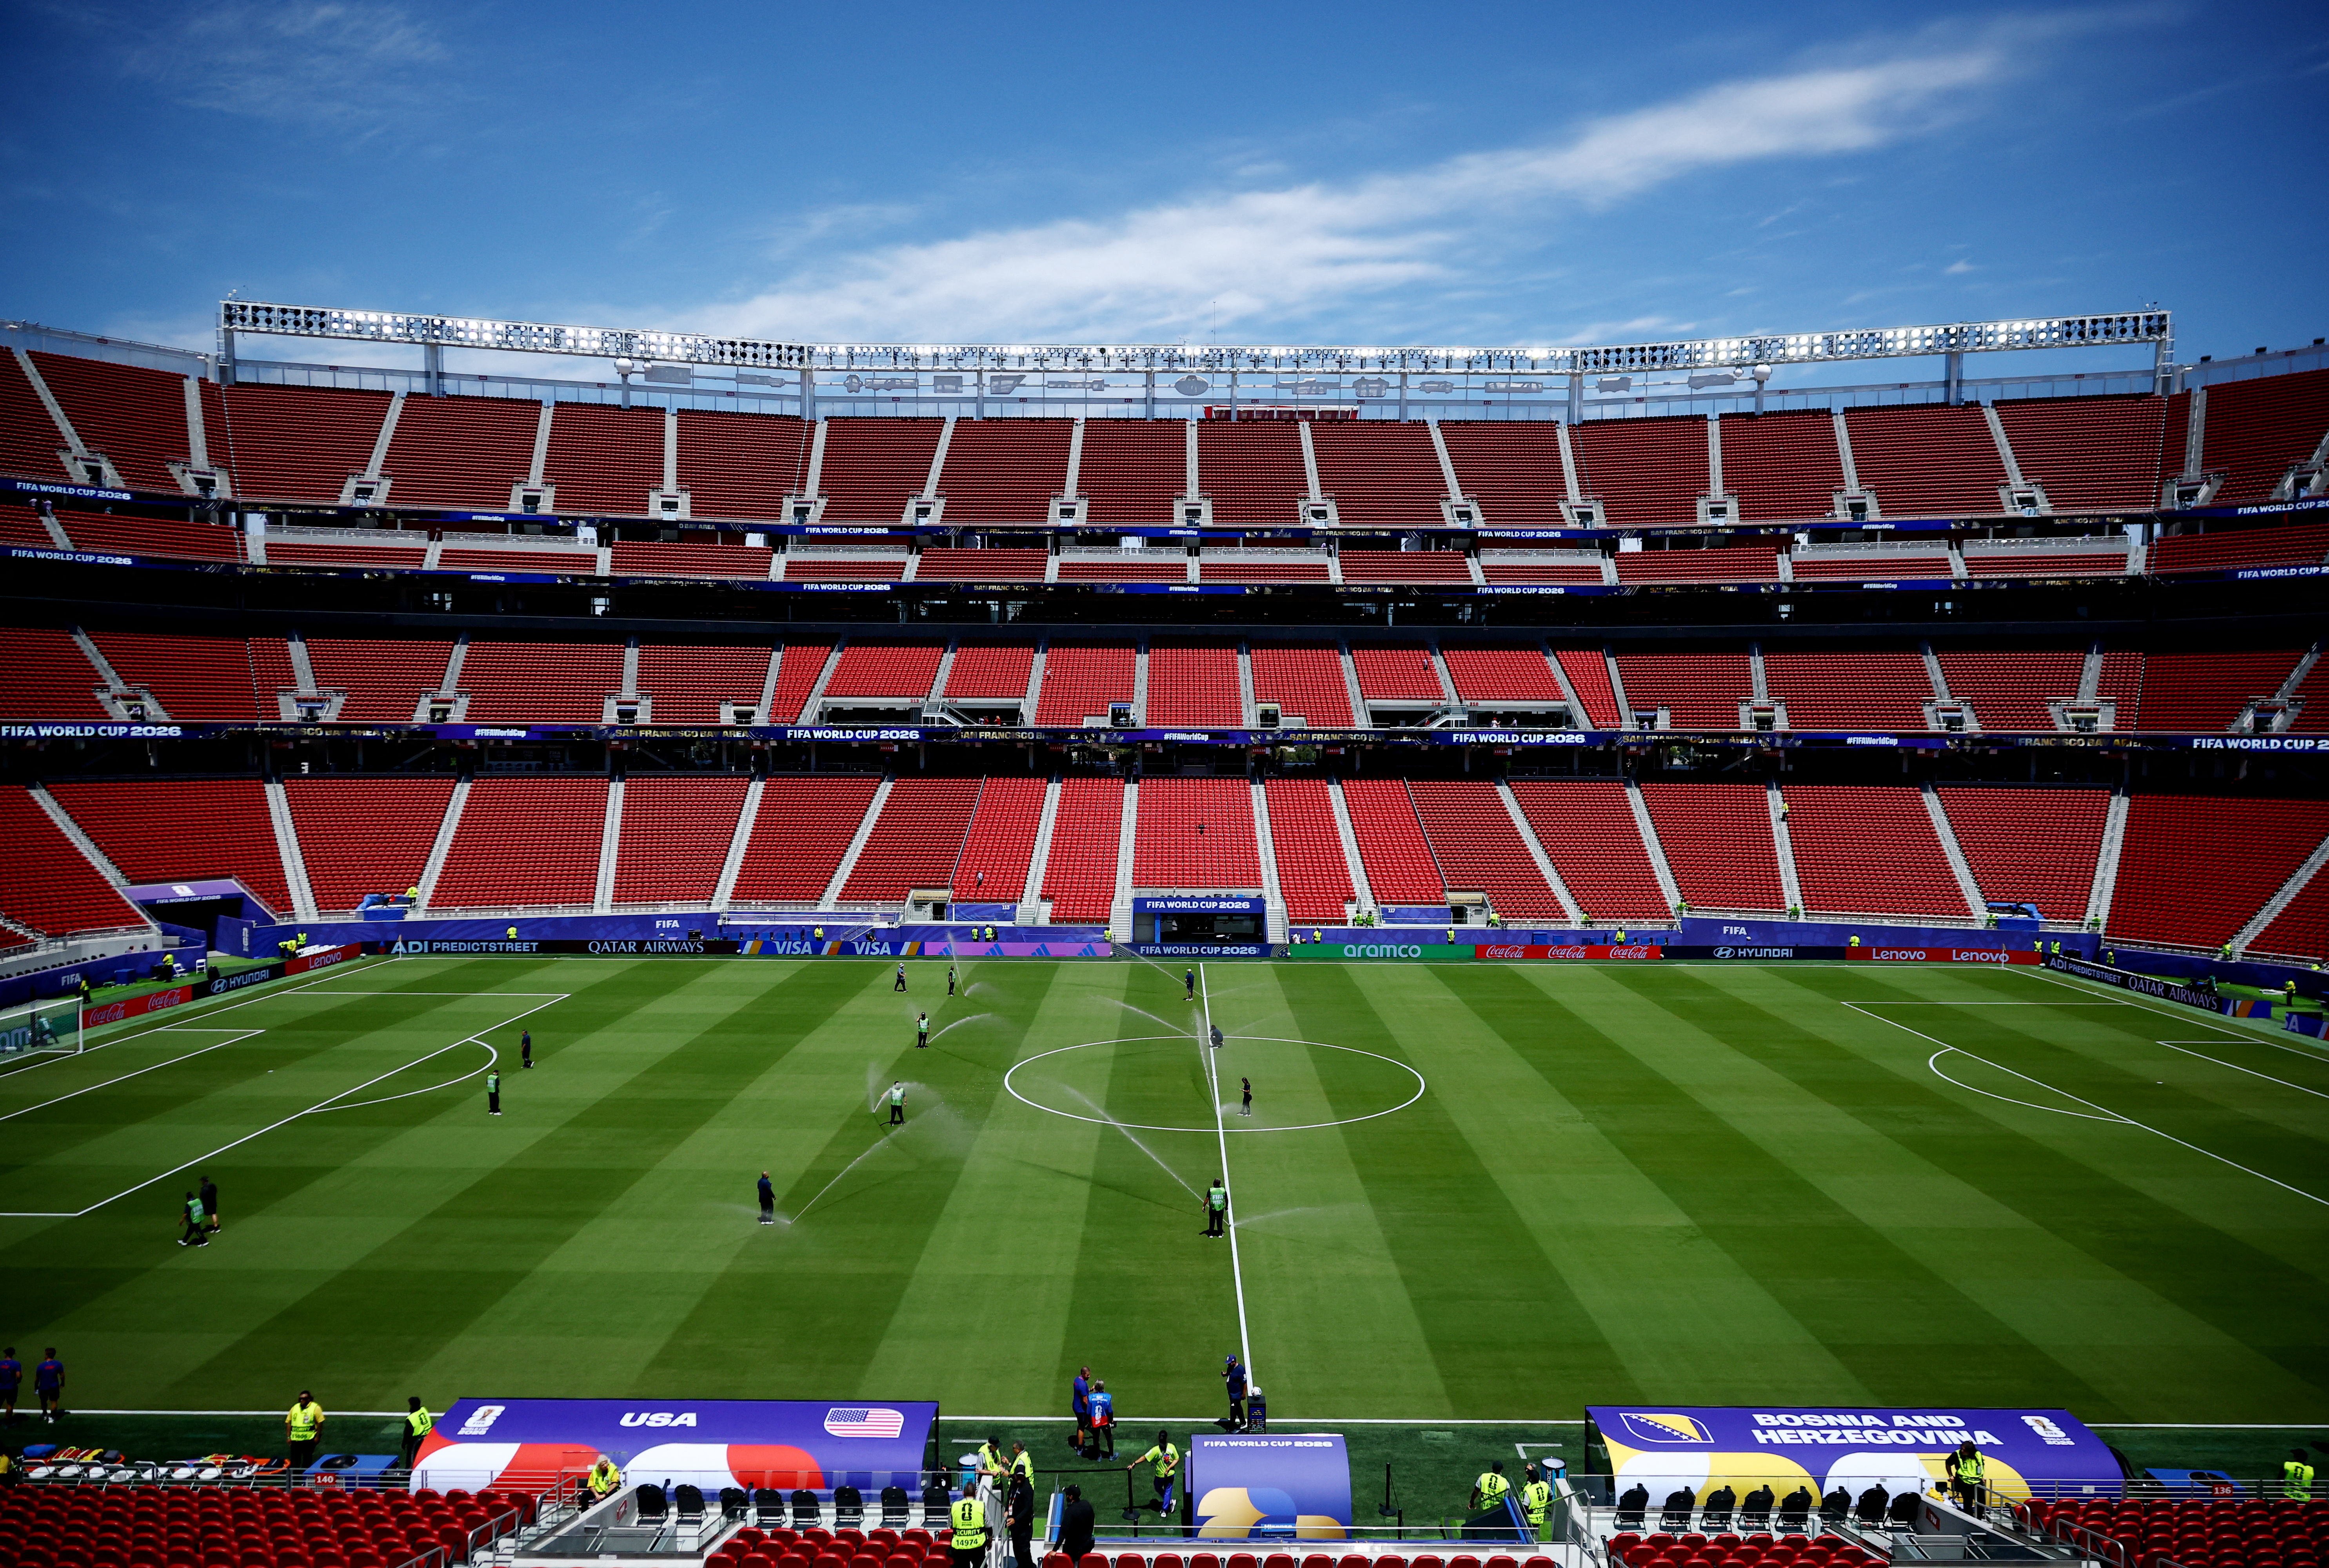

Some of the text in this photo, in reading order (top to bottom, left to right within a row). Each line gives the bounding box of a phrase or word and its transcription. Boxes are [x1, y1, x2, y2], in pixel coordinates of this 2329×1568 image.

[16, 483, 131, 500] FIFA WORLD CUP 2026
[2260, 503, 2294, 513] WORLD
[2296, 501, 2316, 510] CUP
[12, 550, 35, 558] FIFA
[37, 552, 74, 561] WORLD
[76, 554, 94, 562] CUP
[2260, 569, 2297, 578] WORLD
[2299, 568, 2319, 576] CUP
[2, 726, 181, 736] FIFA WORLD CUP 2026
[475, 729, 526, 737] #FIFAWorldCup
[787, 730, 919, 739] FIFA WORLD CUP 2026
[1453, 734, 1585, 742] FIFA WORLD CUP 2026
[1846, 737, 1898, 745] #FIFAWorldCup
[2193, 739, 2224, 748] FIFA
[2225, 739, 2280, 748] WORLD
[2283, 739, 2314, 749] CUP
[1723, 926, 1747, 935] FIFA
[391, 941, 538, 953] ADI PREDICTSTREET
[589, 941, 704, 954] QATAR AIRWAYS
[772, 942, 812, 954] VISA
[851, 942, 891, 955] VISA
[1344, 945, 1421, 957] aramco
[1486, 945, 1526, 958] Coca-Cola
[1548, 945, 1589, 958] Coca-Cola
[1610, 945, 1650, 958] Coca-Cola
[1738, 948, 1792, 957] HYUNDAI
[1873, 948, 1926, 960] Lenovo
[1953, 950, 2009, 962] Lenovo
[309, 952, 341, 969] Lenovo
[2050, 958, 2121, 983] ADI PREDICTSTREET
[62, 973, 81, 986] FIFA
[230, 969, 270, 987] HYUNDAI
[148, 988, 182, 1011] Coca-Cola
[2129, 976, 2216, 1011] QATAR AIRWAYS
[89, 1002, 125, 1026] Coca-Cola
[619, 1412, 697, 1427] USA
[1752, 1414, 1966, 1427] BOSNIA AND
[1751, 1429, 2004, 1445] HERZEGOVINA
[316, 1475, 334, 1484] 140
